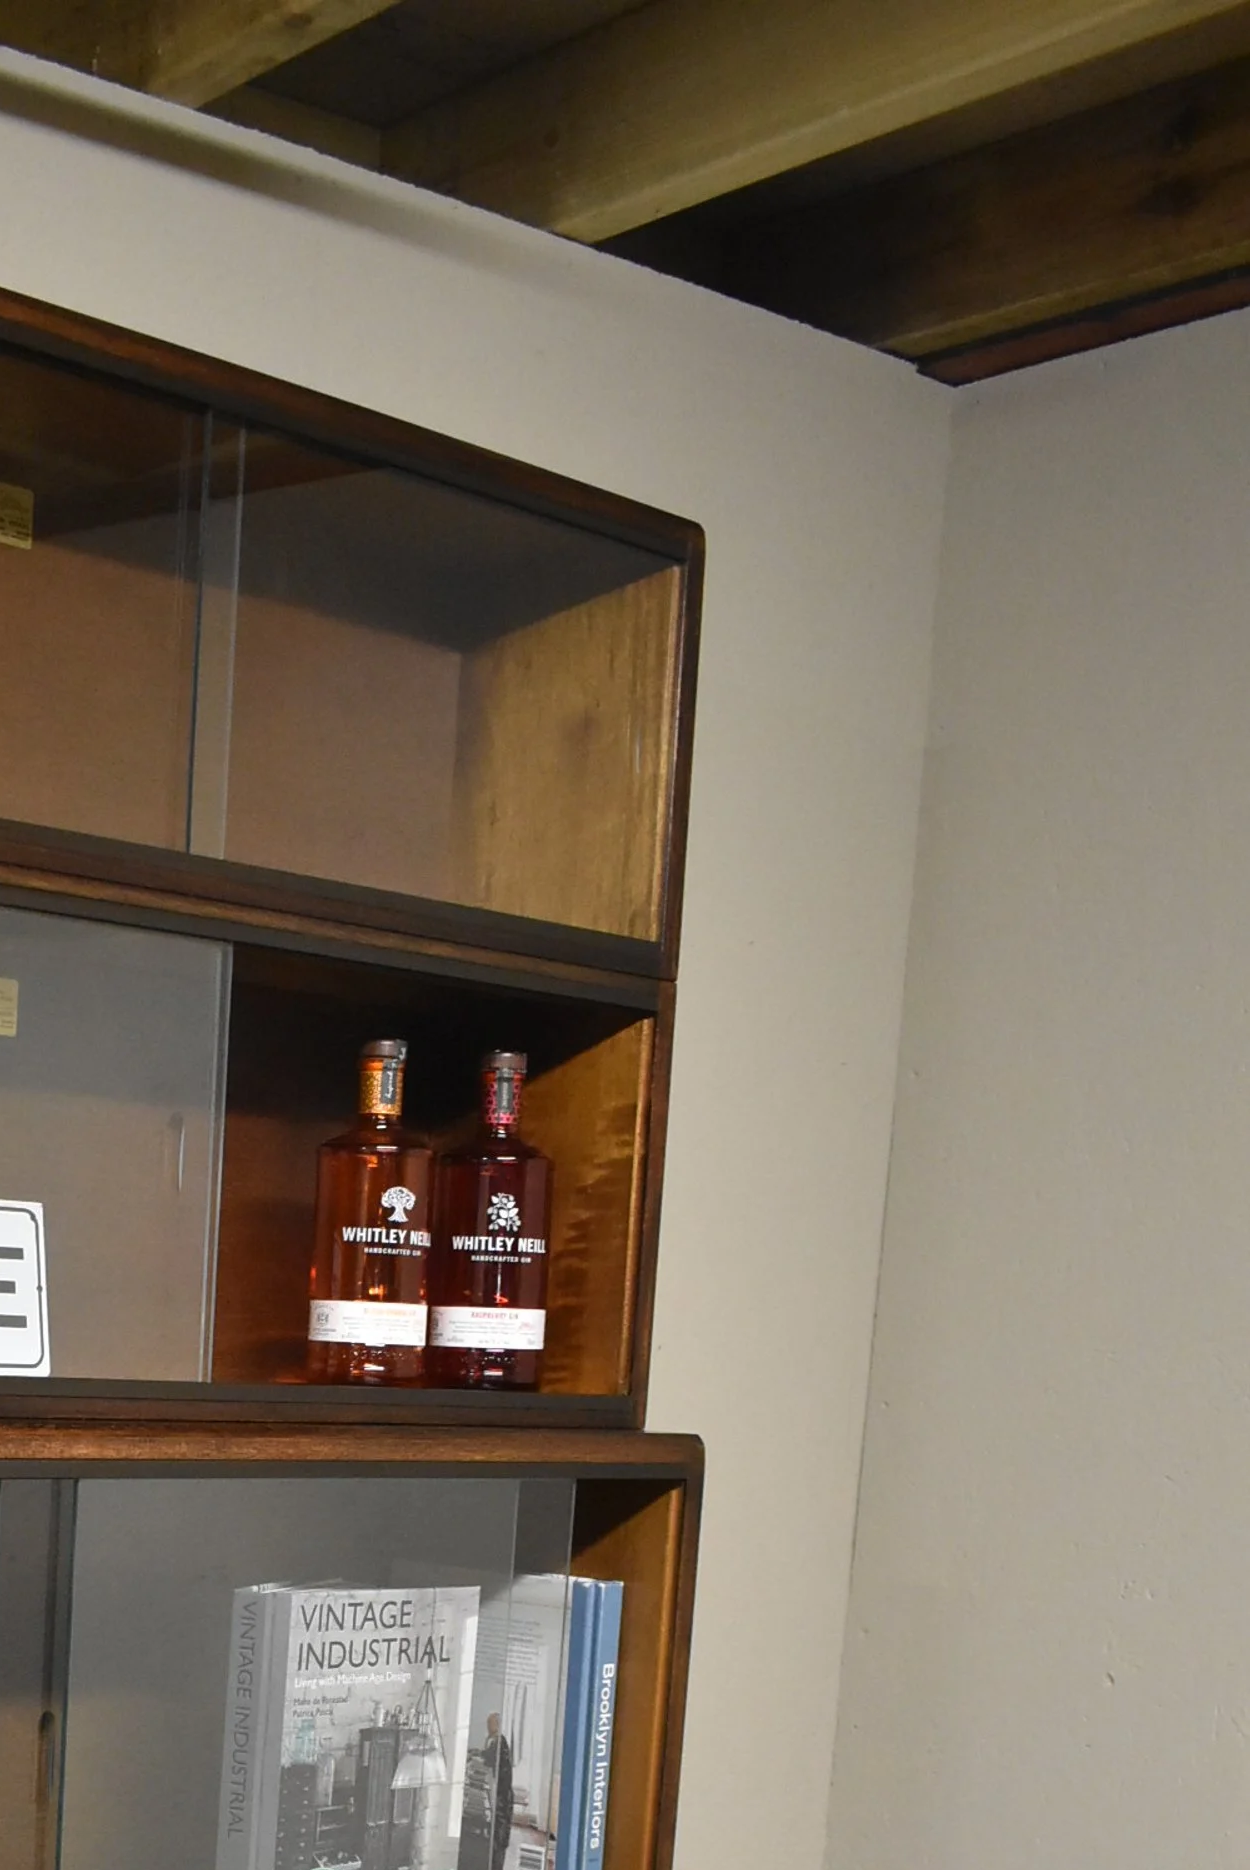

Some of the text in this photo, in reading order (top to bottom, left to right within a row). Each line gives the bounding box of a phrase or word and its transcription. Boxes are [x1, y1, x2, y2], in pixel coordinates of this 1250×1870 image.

[342, 1227, 407, 1244] WHITLEY
[452, 1236, 546, 1254] WHITLEY NEILL
[301, 1600, 412, 1632] VINTAGE
[297, 1636, 451, 1671] INDUSTRIAL
[294, 1678, 317, 1690] Living
[386, 1671, 411, 1684] Design
[227, 1601, 257, 1839] VINTAGE INDUSTRIAL
[590, 1663, 615, 1849] Brooklyn Interiors
